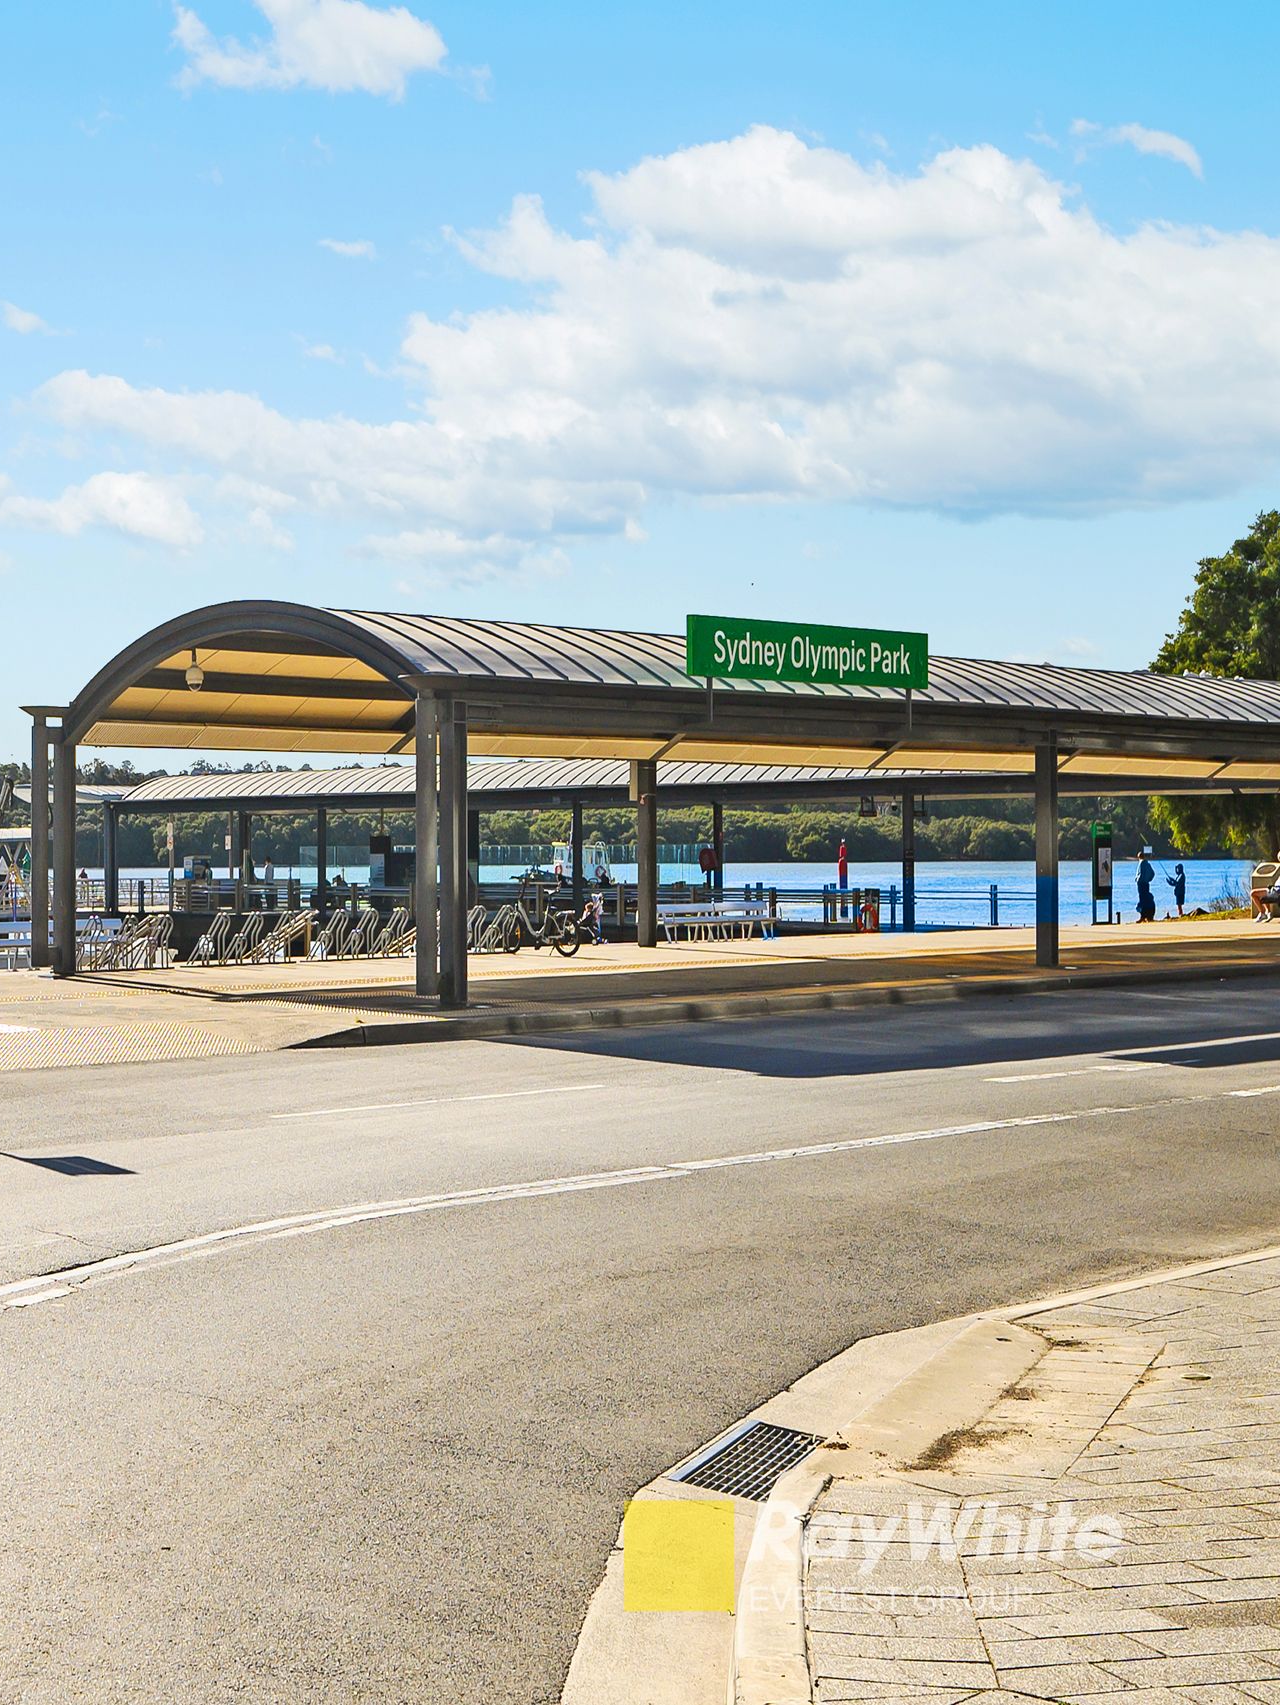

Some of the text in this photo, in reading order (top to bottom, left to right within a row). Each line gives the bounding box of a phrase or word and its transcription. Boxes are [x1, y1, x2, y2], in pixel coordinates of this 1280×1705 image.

[713, 630, 911, 679] Sydney Olympic Park
